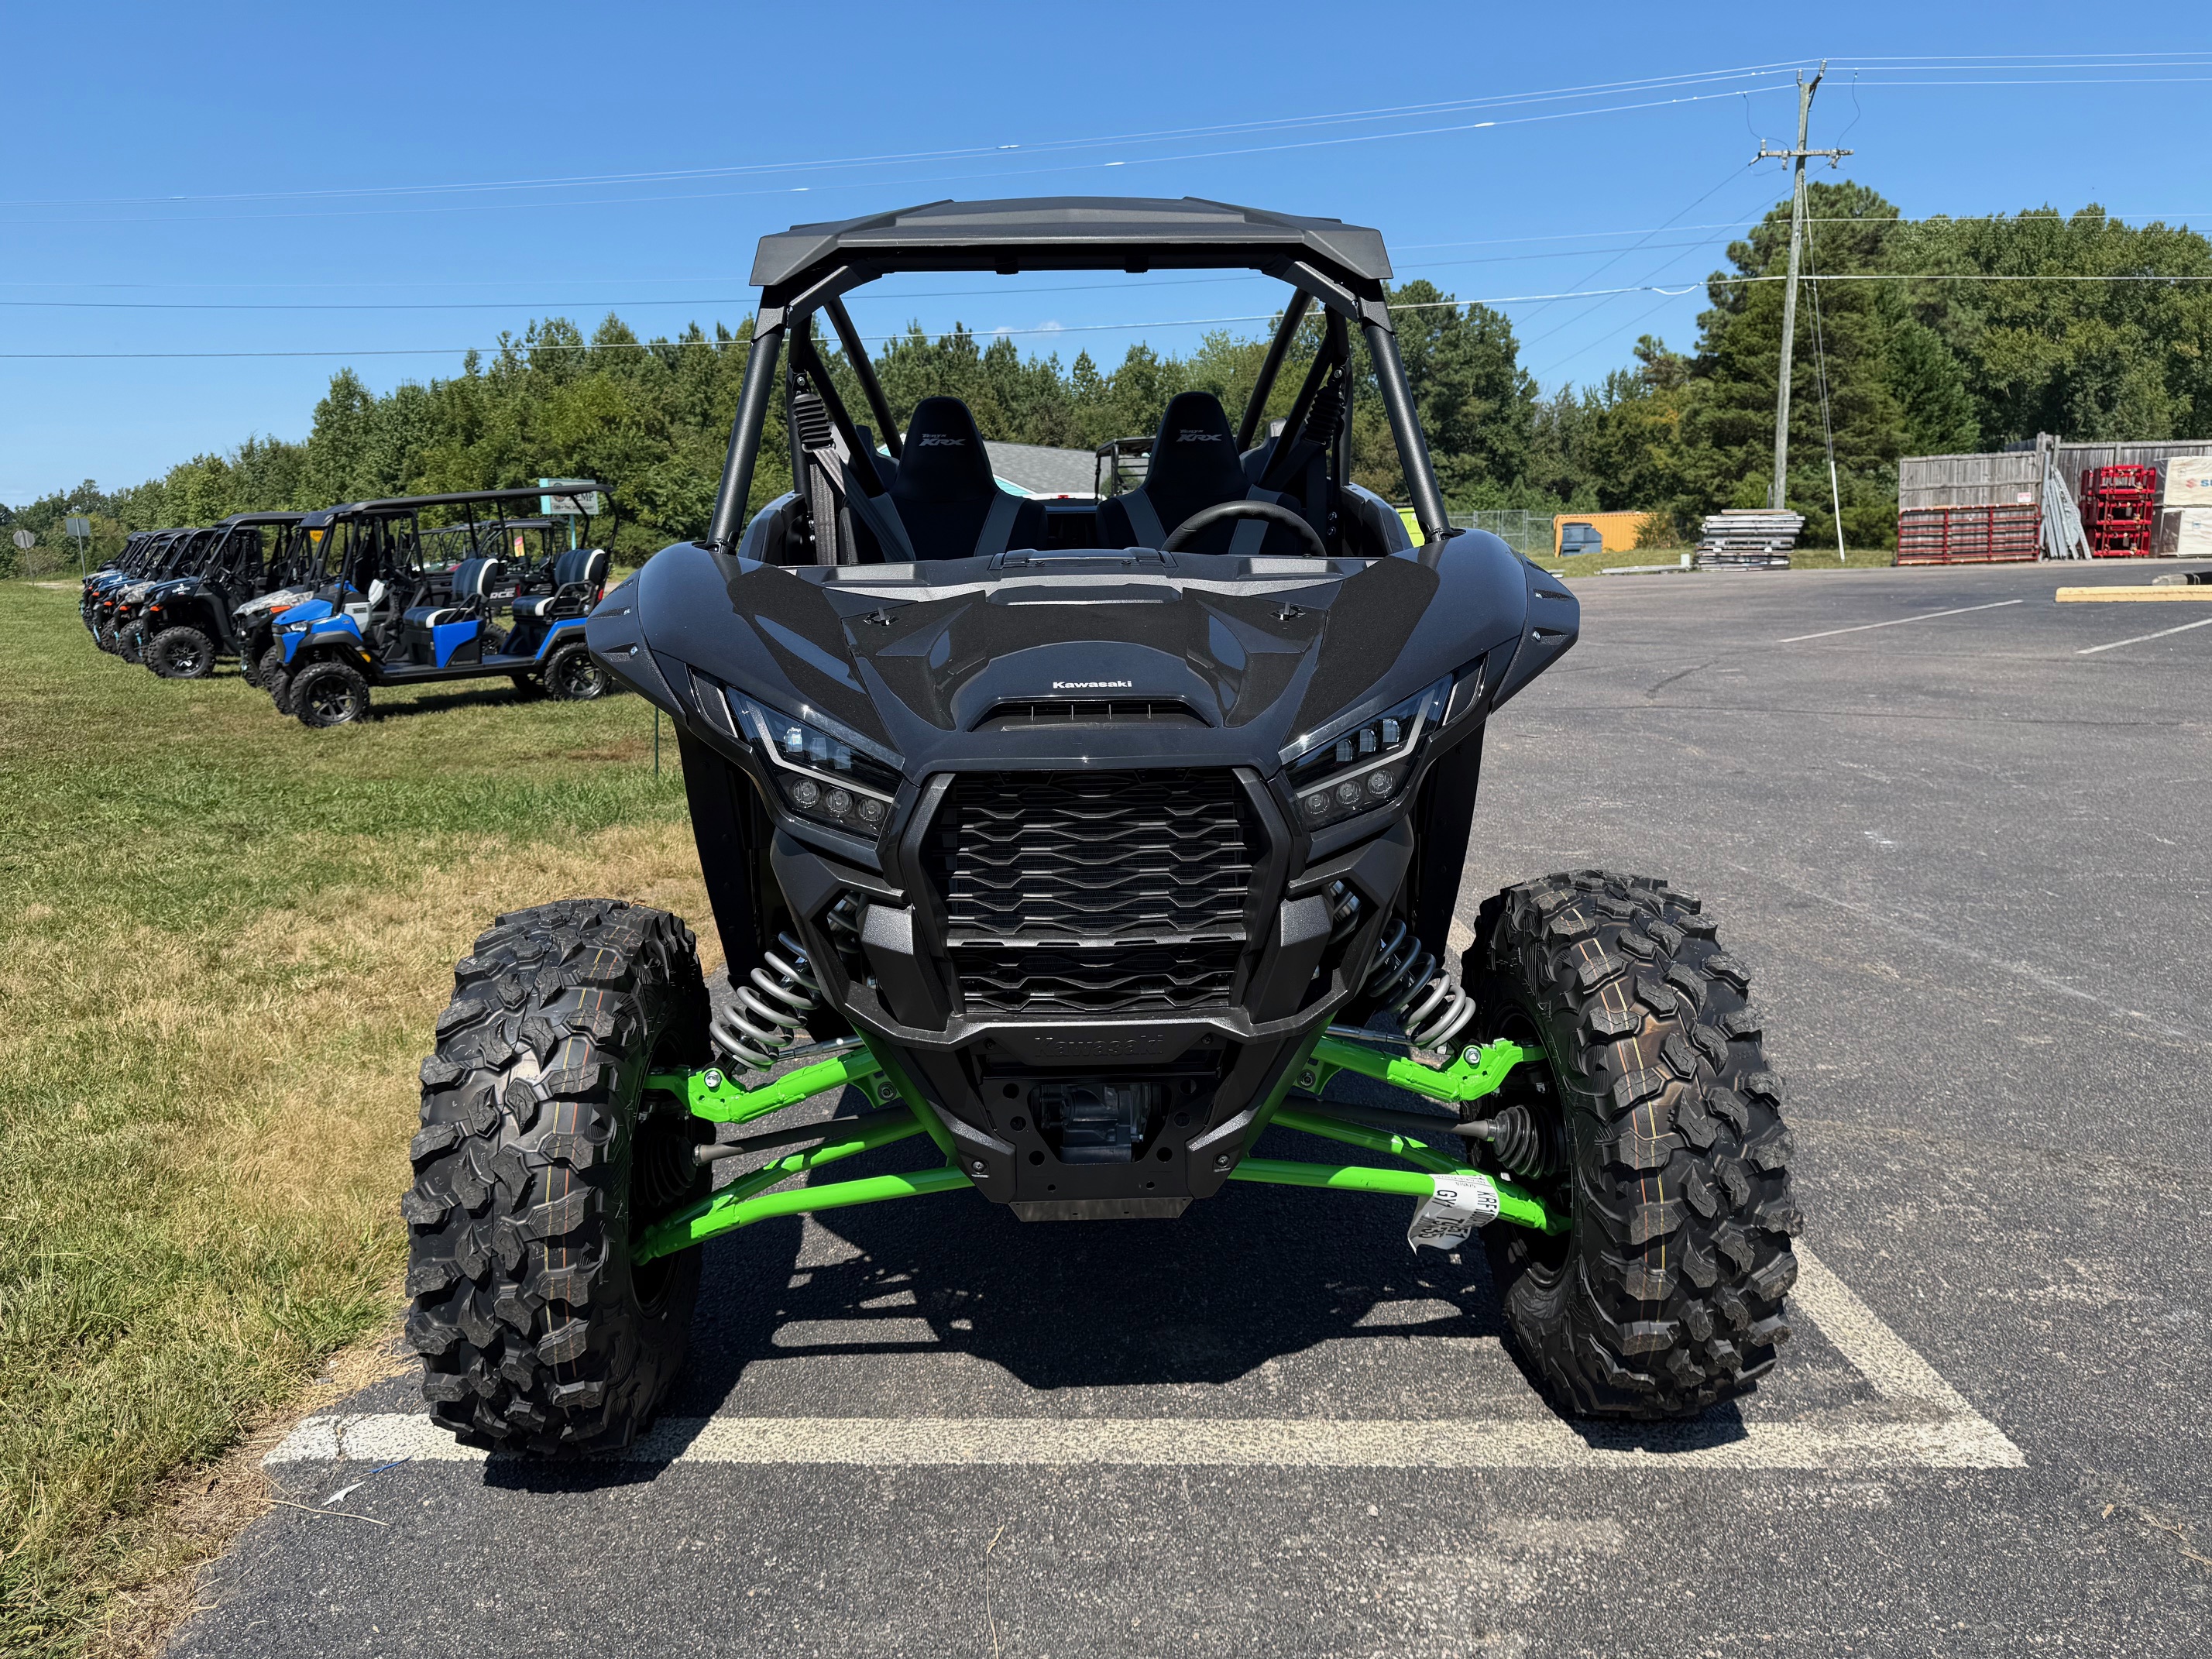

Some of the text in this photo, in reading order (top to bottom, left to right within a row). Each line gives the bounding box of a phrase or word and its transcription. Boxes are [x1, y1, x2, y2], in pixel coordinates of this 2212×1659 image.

[919, 438, 967, 447] KRX
[1176, 434, 1223, 442] KRX
[1053, 680, 1132, 689] Kawasaki
[1034, 1035, 1163, 1057] Kawasaki
